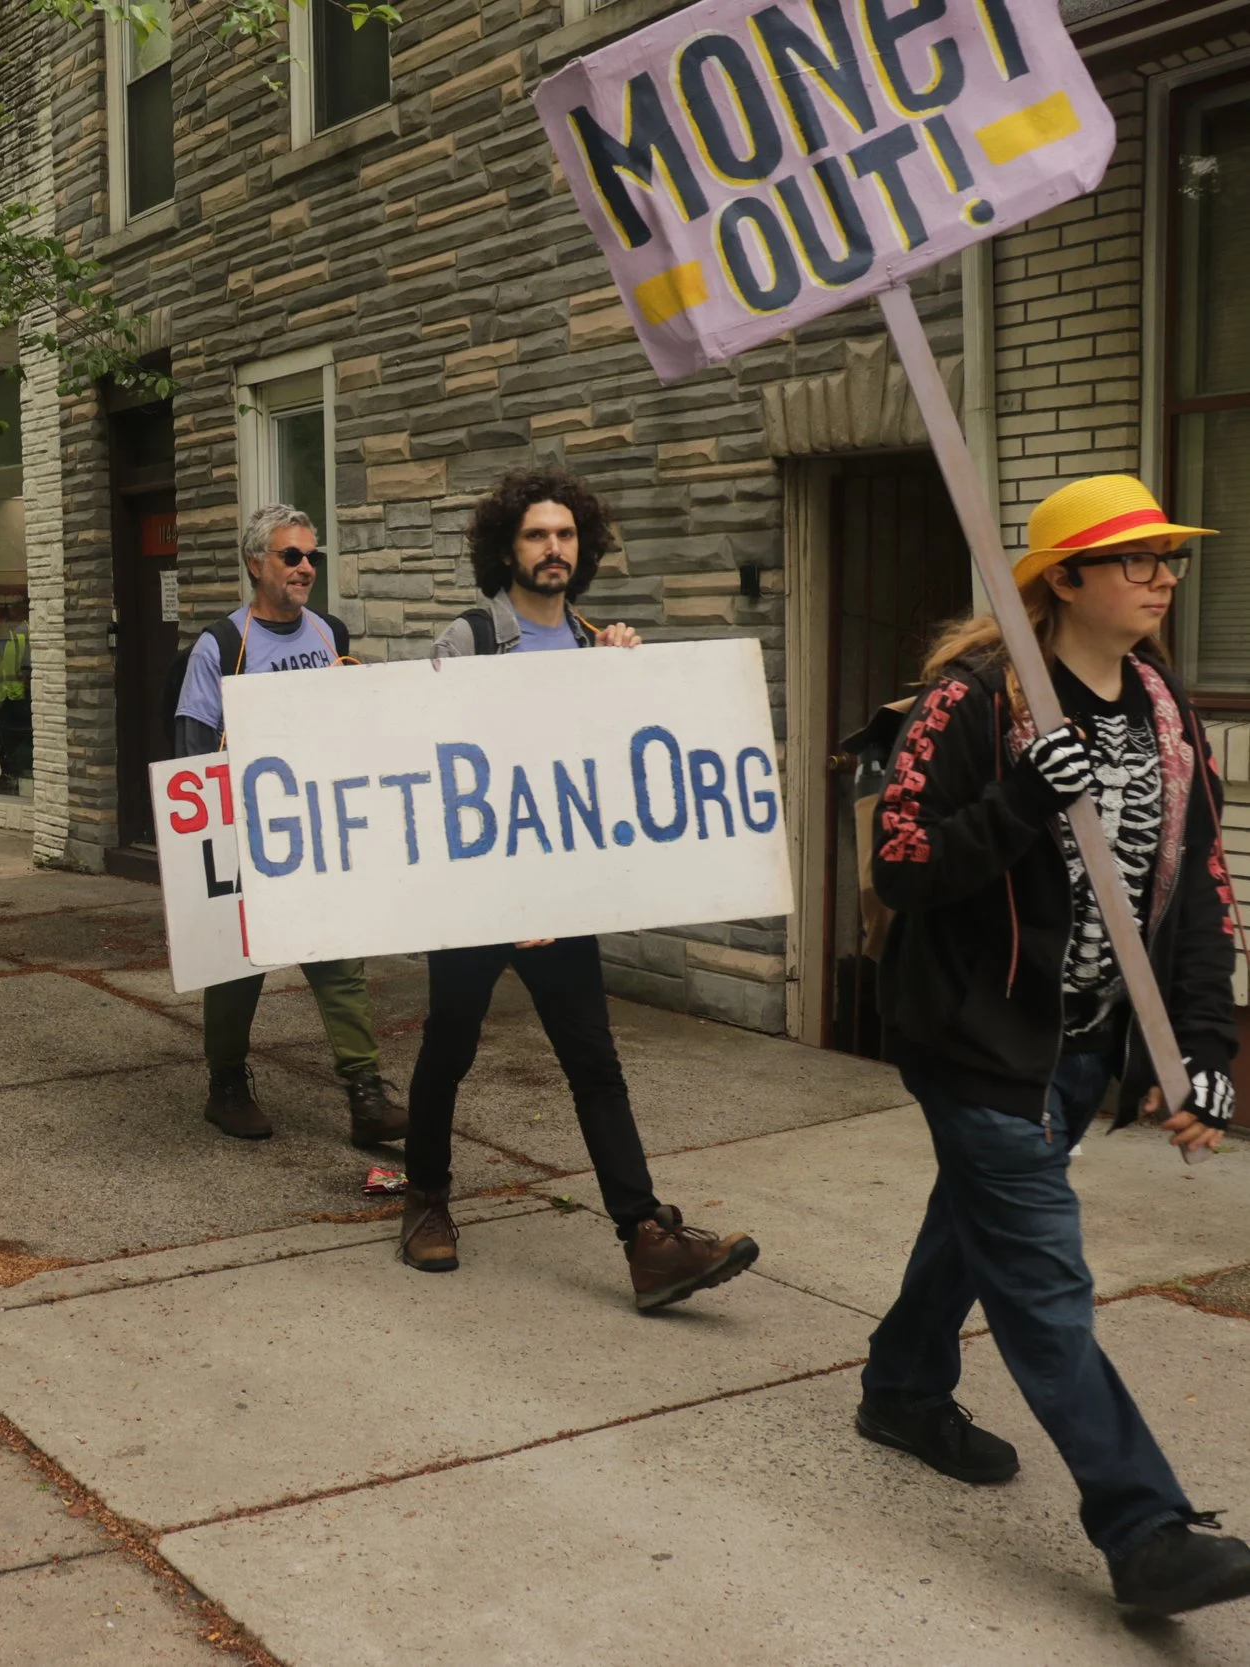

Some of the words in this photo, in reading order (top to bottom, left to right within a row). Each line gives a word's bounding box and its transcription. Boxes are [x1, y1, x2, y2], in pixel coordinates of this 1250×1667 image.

[712, 113, 995, 316] OUT!
[271, 650, 330, 672] MARCH
[167, 764, 234, 834] ST
